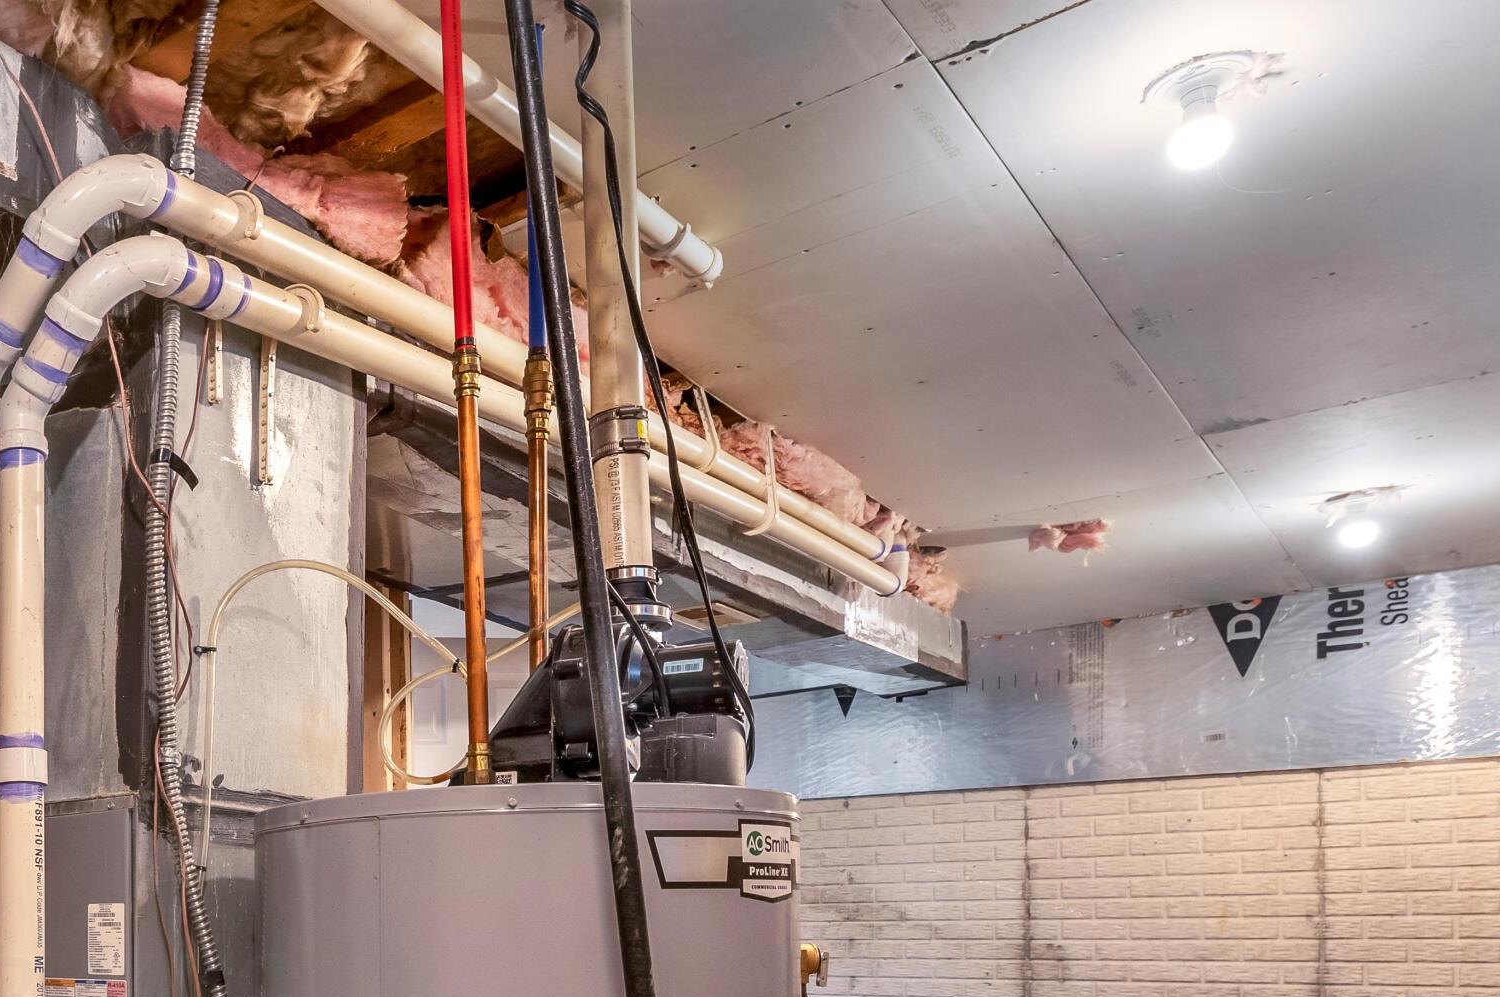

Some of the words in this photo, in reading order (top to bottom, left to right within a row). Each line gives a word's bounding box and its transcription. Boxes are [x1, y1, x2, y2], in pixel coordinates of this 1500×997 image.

[1316, 587, 1366, 660] Ther
[33, 802, 43, 846] F891-10
[764, 835, 790, 854] Smith
[34, 848, 43, 871] NSF
[749, 866, 781, 877] ProLine
[781, 867, 789, 877] XE
[33, 955, 44, 974] ME
